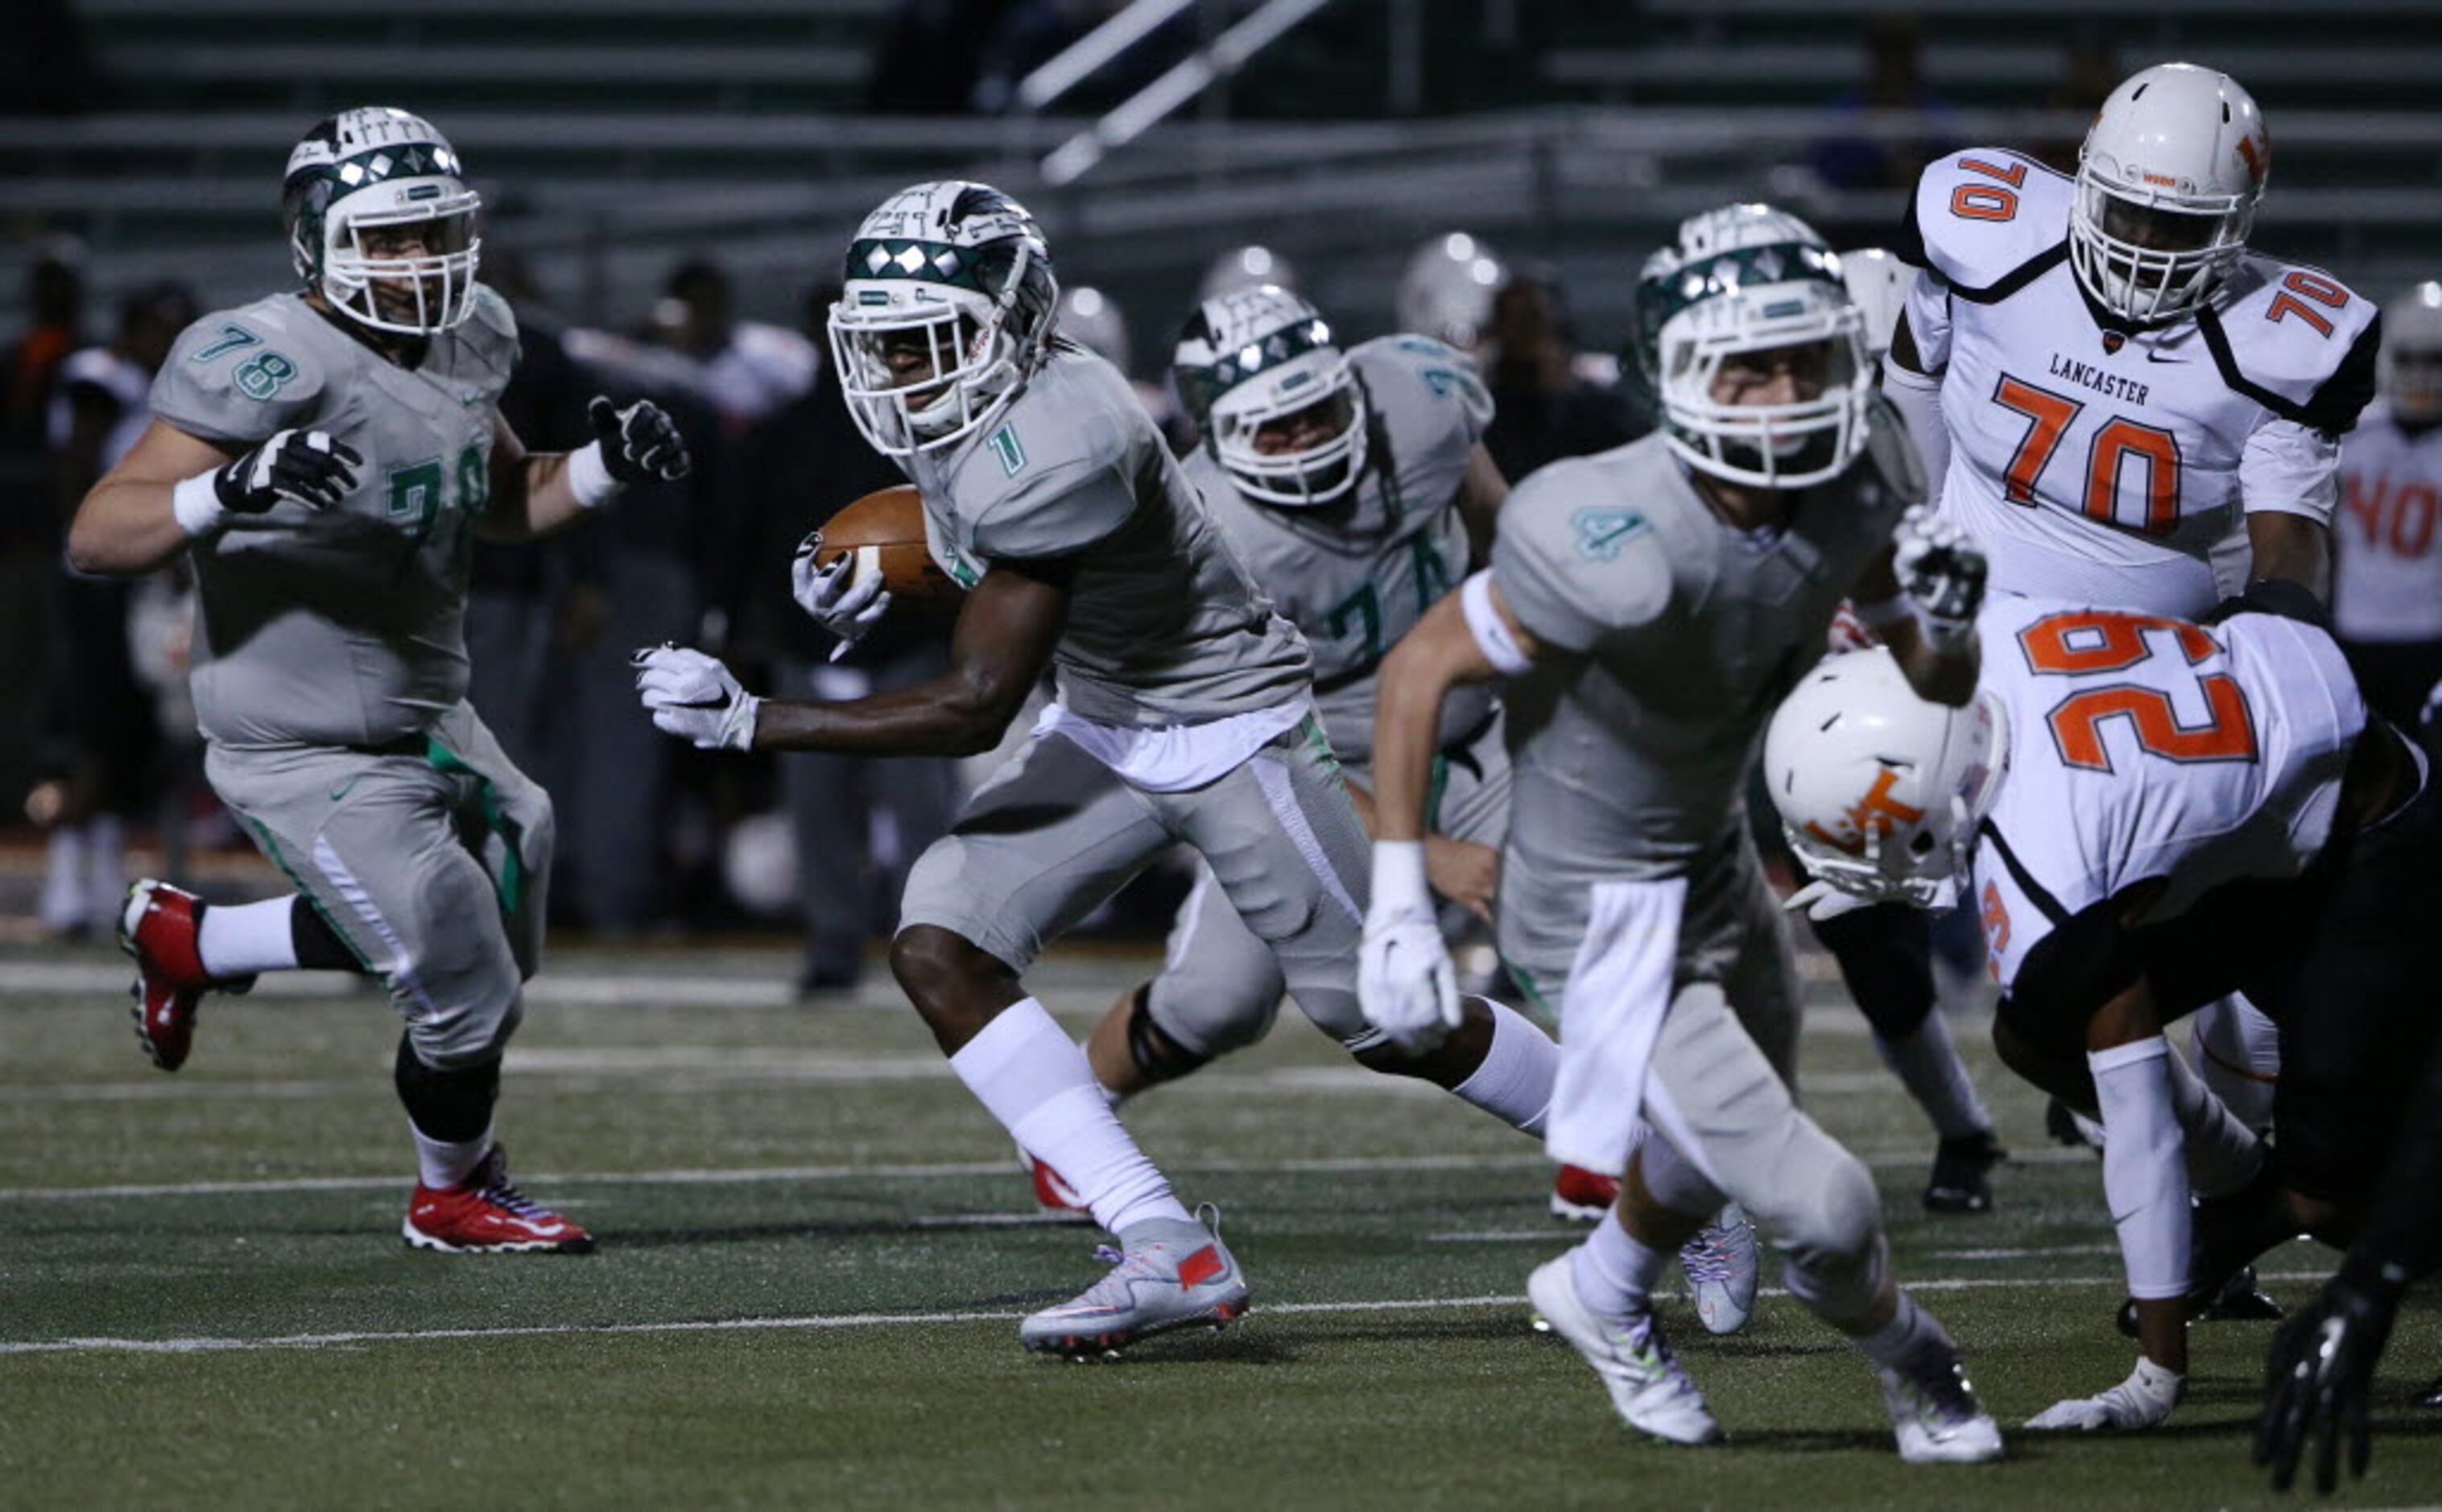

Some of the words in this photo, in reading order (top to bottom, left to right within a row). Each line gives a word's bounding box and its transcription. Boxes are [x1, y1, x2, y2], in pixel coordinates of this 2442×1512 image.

[1950, 158, 2027, 221] 70
[2265, 271, 2349, 338] 70
[188, 324, 299, 401] 78
[2049, 353, 2149, 406] LANCASTER
[989, 421, 1027, 477] 1
[1992, 371, 2182, 537] 70
[1570, 505, 1655, 564] 4
[2344, 472, 2437, 561] 40
[2014, 608, 2259, 775] 29
